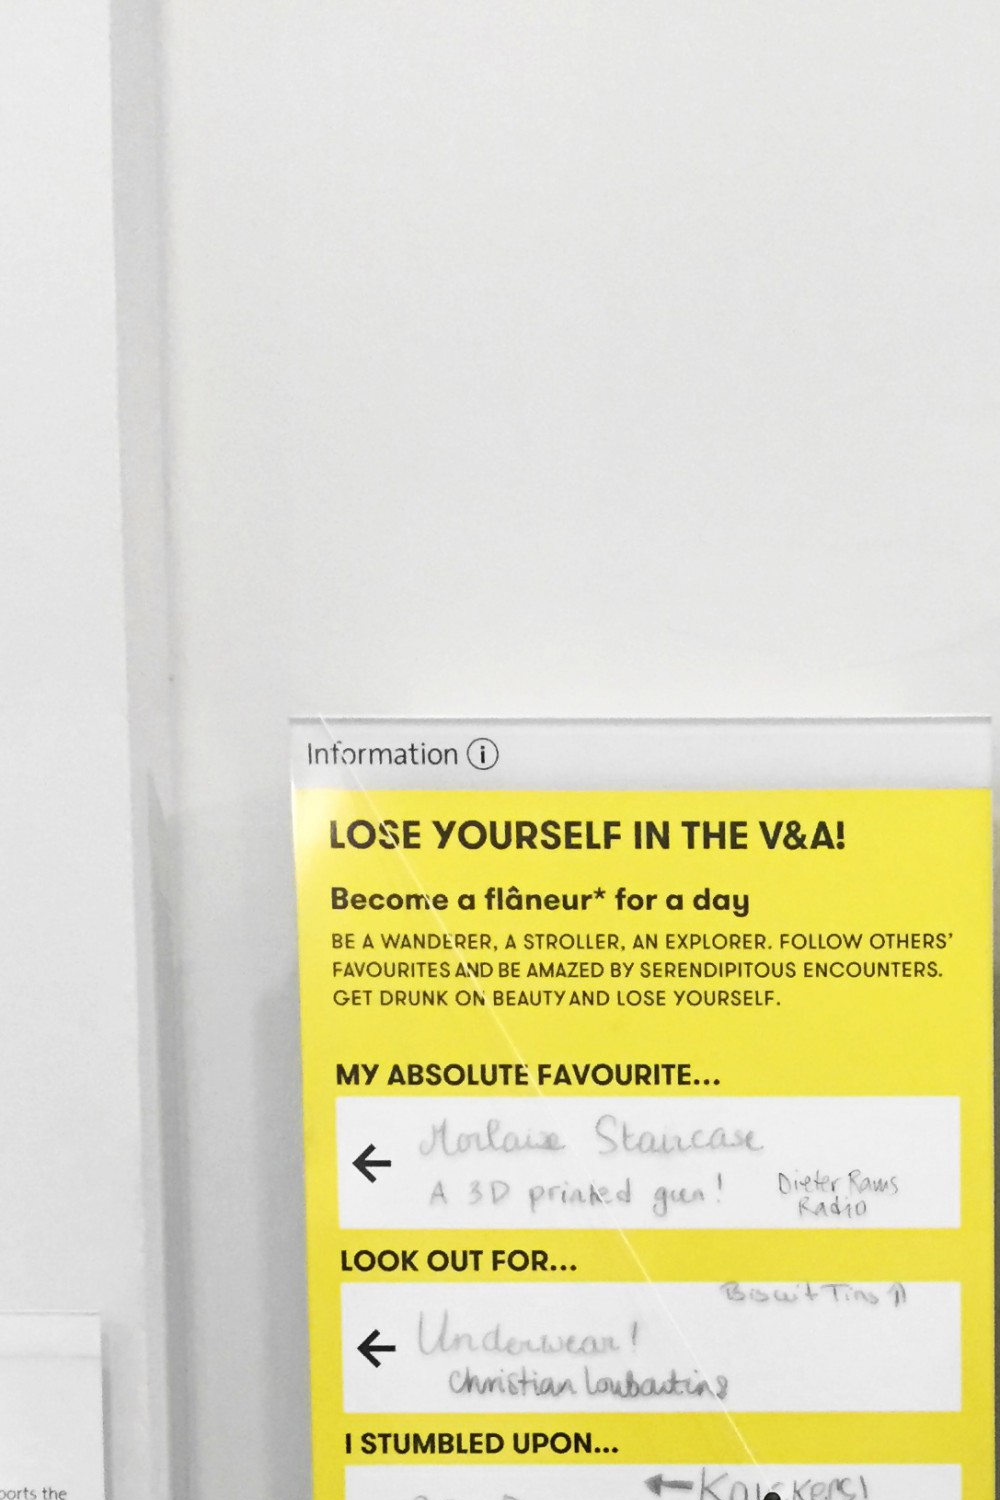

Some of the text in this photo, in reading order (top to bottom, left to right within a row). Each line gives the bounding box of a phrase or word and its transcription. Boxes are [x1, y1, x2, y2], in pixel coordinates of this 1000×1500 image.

[308, 740, 458, 765] Information
[330, 819, 845, 850] LOSE YOURSELF IN THE V&A!
[331, 887, 448, 910] Become
[457, 894, 475, 910] a
[615, 887, 658, 911] for
[666, 894, 683, 910] a
[693, 887, 749, 917] day
[332, 933, 953, 952] BE A WANDERER, A STROLLER, AN EXPLORER. FOLLOW OTHERS’
[333, 961, 942, 978] FAVOURITES AND BE AMAZED BY SERENDIPITOUS ENCOUNTERS.
[333, 990, 780, 1006] GET DRUNK ON BEAUTY AND LOSE YOURSELF.
[336, 1063, 720, 1086] MY ABSOLUTE FAVOURITE...
[595, 1114, 764, 1155] Staircase
[430, 1172, 722, 1217] A 3D printed gun!
[799, 1196, 866, 1218] Radio
[341, 1249, 577, 1272] LOOK OUT FOR...
[419, 1312, 639, 1356] Underwear!
[345, 1432, 619, 1455] I STUMBLED UPON...
[42, 1487, 67, 1500] the
